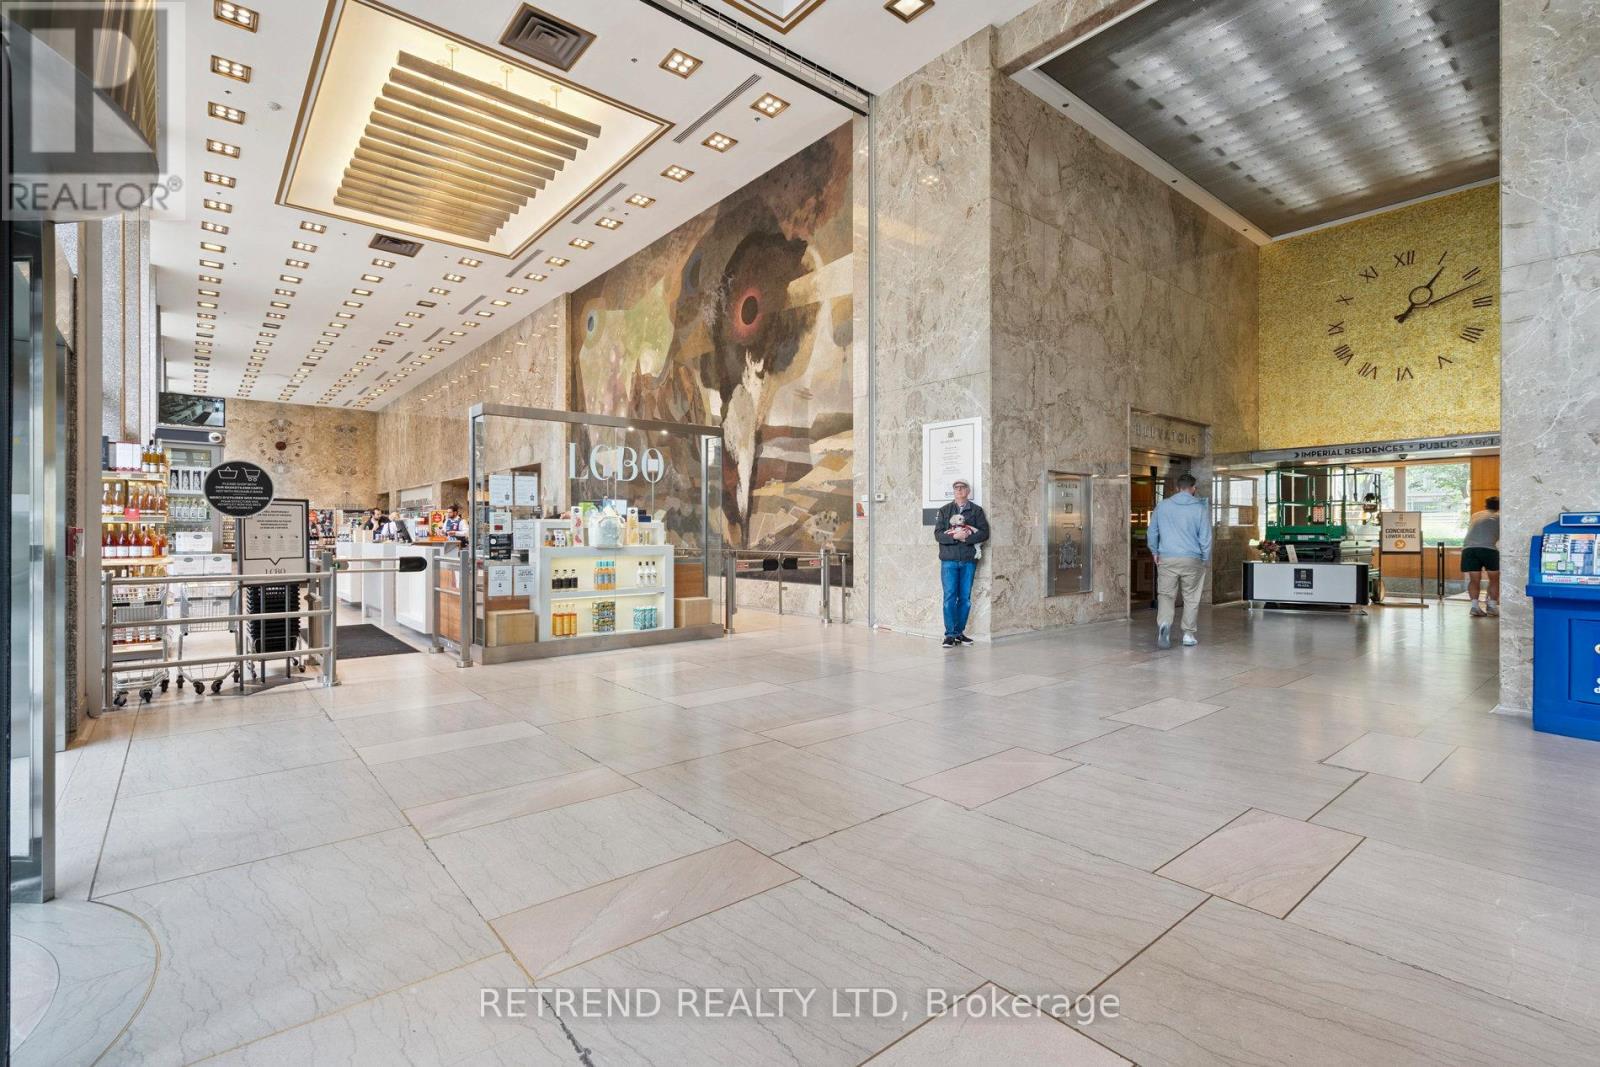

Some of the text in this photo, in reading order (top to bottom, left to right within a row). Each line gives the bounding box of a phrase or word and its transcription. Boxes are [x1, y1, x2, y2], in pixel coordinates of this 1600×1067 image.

[1393, 250, 1415, 268] XII
[1358, 265, 1379, 283] XI
[1335, 294, 1354, 306] X
[1328, 321, 1345, 336] IX
[1358, 362, 1378, 380] VII
[1438, 355, 1453, 370] V
[1396, 367, 1414, 382] VI
[1301, 448, 1342, 458] IMPERIAL
[1344, 444, 1404, 456] RESIDENCES
[1419, 440, 1458, 450] PUBLIC
[568, 442, 665, 483] LCBO
